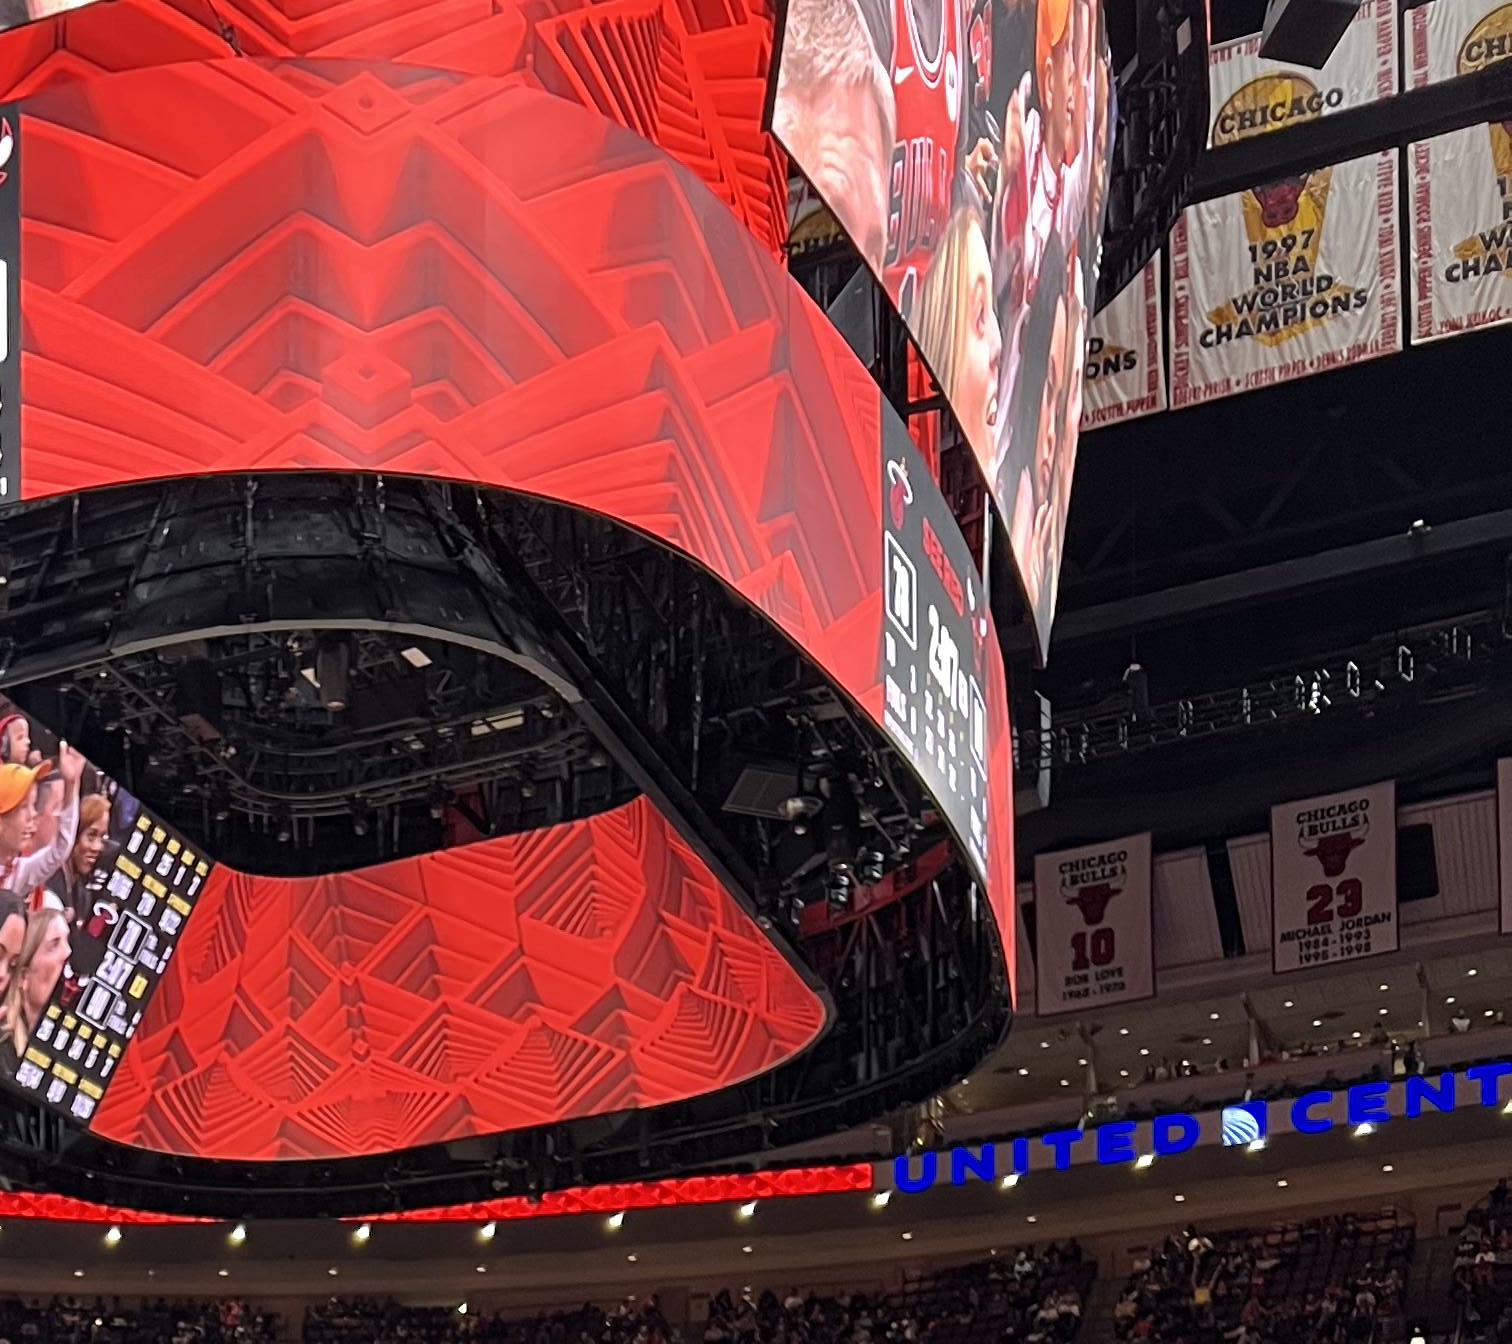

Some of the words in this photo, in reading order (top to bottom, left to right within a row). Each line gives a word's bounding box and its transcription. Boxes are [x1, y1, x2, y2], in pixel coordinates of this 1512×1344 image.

[1220, 87, 1344, 135] CHICAGO
[1248, 228, 1316, 264] 1997
[1253, 255, 1311, 287] NBA
[1232, 275, 1335, 315] WORLD
[1199, 288, 1369, 349] CHAMPIONS
[1296, 798, 1370, 825] CHICAGO
[1307, 814, 1360, 837] BULLS
[1059, 850, 1128, 875] CHICAGO
[1069, 866, 1118, 887] BULLS
[1306, 878, 1363, 926] 23
[1280, 923, 1334, 944] MICHAEL
[1339, 911, 1392, 932] JORDAN
[1071, 927, 1115, 971] 10
[893, 1112, 1200, 1193] UNITED
[1290, 1061, 1512, 1135] CENT
